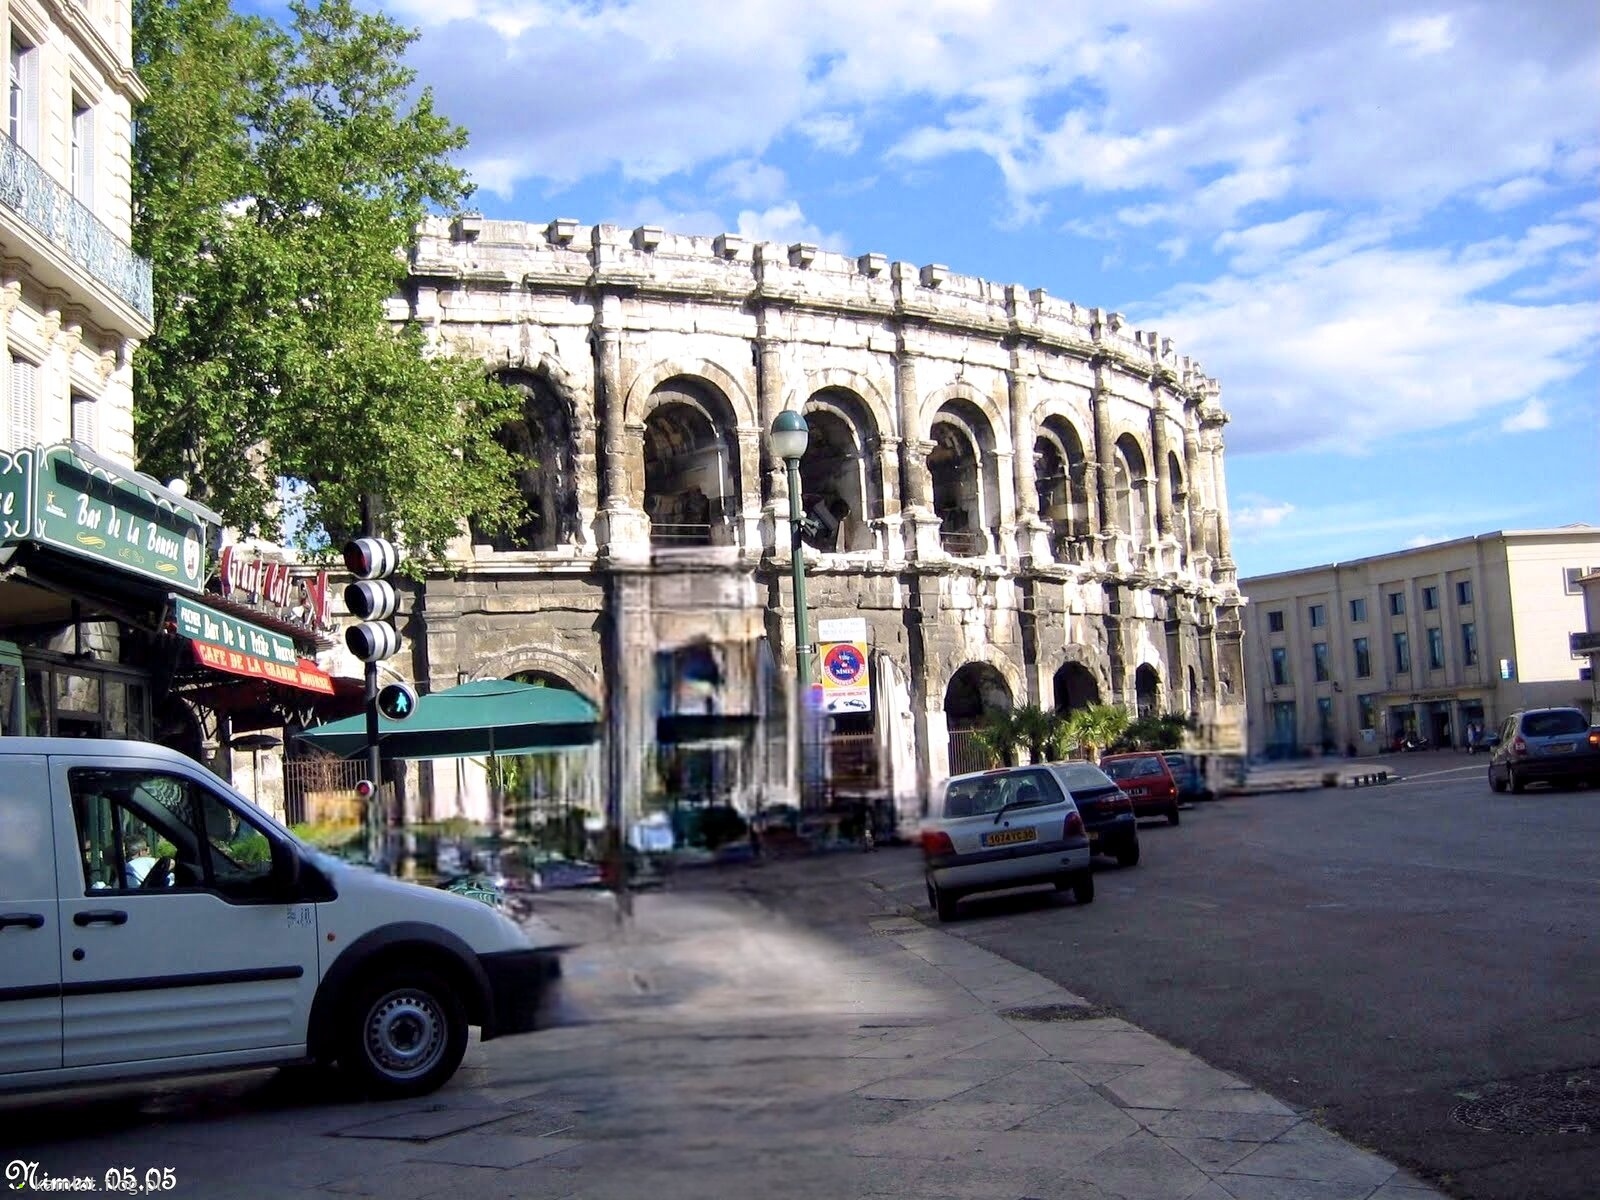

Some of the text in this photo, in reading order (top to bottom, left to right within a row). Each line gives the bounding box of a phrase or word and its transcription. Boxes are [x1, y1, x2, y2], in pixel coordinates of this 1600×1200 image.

[77, 493, 102, 530] Bar
[107, 505, 121, 538] de
[229, 651, 244, 670] DE
[246, 655, 264, 674] LA
